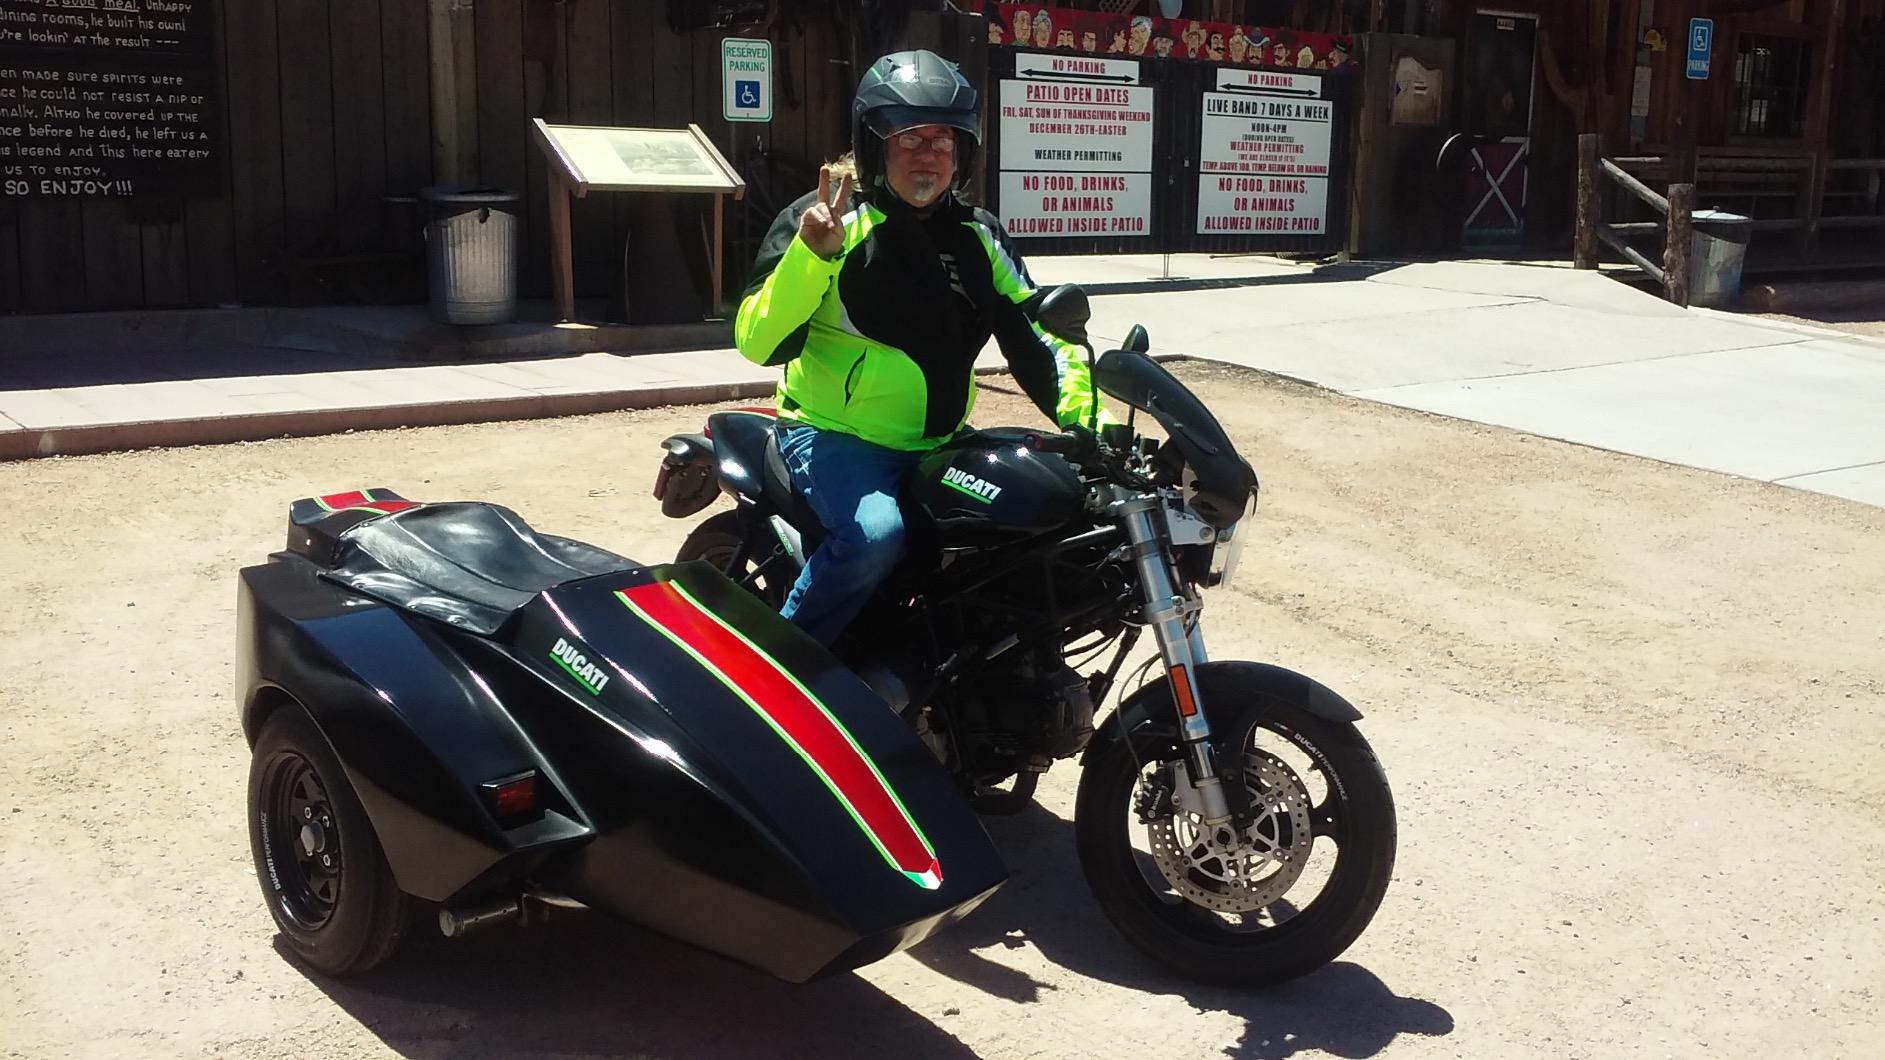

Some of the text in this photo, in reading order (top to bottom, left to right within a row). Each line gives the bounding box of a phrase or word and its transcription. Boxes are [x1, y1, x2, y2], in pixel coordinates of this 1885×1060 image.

[42, 13, 89, 29] rooms,
[91, 14, 103, 27] he
[138, 16, 154, 29] his
[726, 47, 767, 58] RESERVED
[729, 60, 765, 72] PARKING
[1052, 59, 1105, 74] NO PARKING
[1248, 74, 1293, 87] NO PARKING
[22, 86, 37, 98] he
[40, 87, 76, 100] could
[1026, 85, 1129, 103] PATIO OPEN DATES
[86, 107, 100, 120] he
[104, 108, 154, 121] covered
[177, 113, 199, 122] THE
[1036, 108, 1050, 119] SUN
[1052, 109, 1062, 119] OF
[1063, 109, 1117, 121] THANKSGIVING
[1118, 110, 1150, 122] WEEKEND
[1207, 98, 1329, 119] LIVE BAND 7 DAYS A WEEK
[79, 125, 94, 138] he
[99, 126, 131, 140] died,
[135, 127, 149, 139] he
[1029, 123, 1127, 136] DECEMBER 26TH-EASTER
[1251, 123, 1287, 134] NOON-4PM
[133, 145, 162, 158] here
[1230, 141, 1304, 154] WEATHER PERMITTING
[1034, 149, 1122, 162] WEATHER PERMITTING
[1305, 166, 1327, 174] RAINING
[5, 180, 133, 196] SO ENJOY!!!
[1023, 176, 1128, 192] NO FOOD, DRINKS,
[1219, 178, 1308, 194] NO FOOD, DRINKS,
[1042, 197, 1113, 212] OR ANIMALS
[1234, 198, 1294, 212] OR ANIMALS
[1008, 217, 1143, 233] ALLOWED INSIDE PATIO
[1204, 216, 1319, 231] ALLOWED INSIDE PATIO
[943, 466, 1002, 500] DUCATI
[552, 637, 610, 691] DUCATI
[1294, 733, 1324, 758] DUCATI
[266, 858, 281, 890] DUCATI
